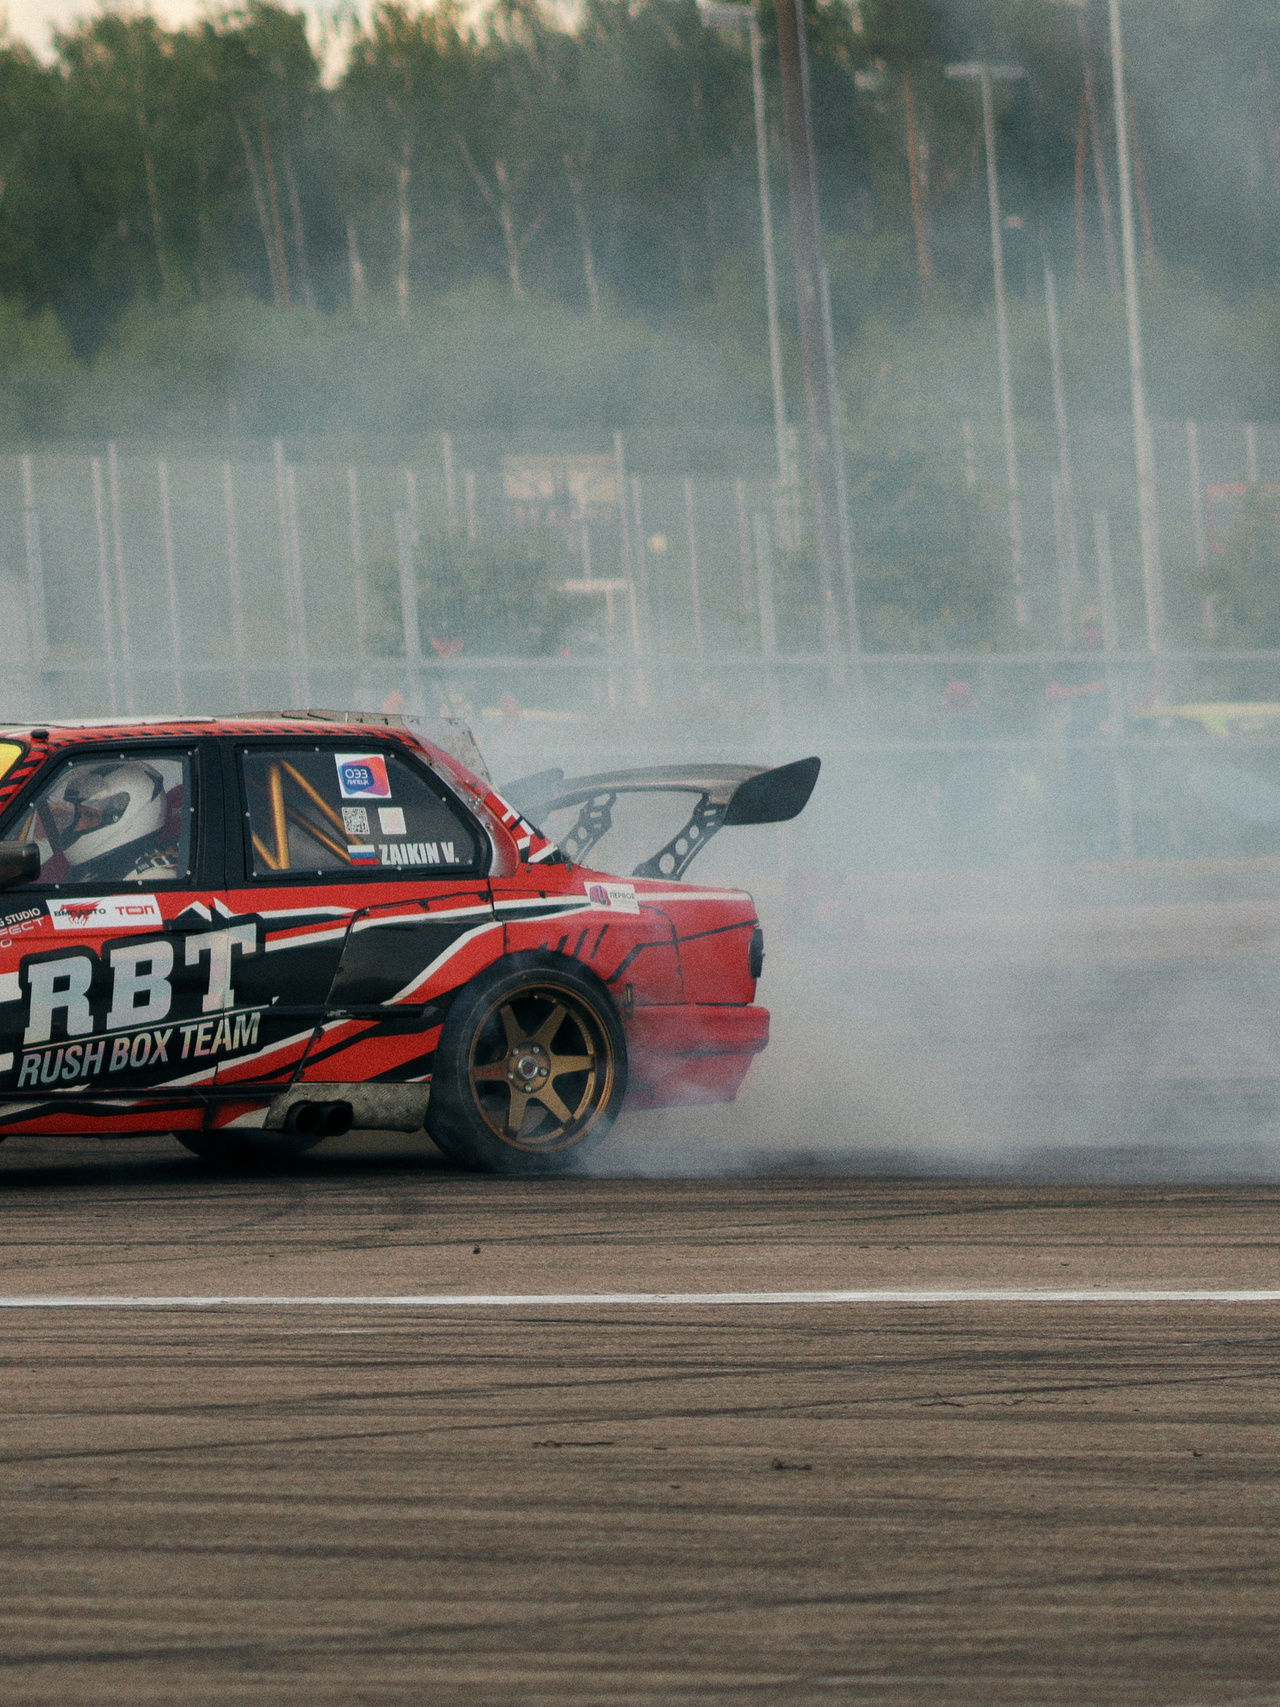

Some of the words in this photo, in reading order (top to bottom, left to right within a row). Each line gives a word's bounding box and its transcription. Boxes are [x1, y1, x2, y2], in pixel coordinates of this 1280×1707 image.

[345, 768, 369, 779] ОЭЗ
[378, 842, 441, 866] ZAIKIN
[441, 841, 460, 864] V.
[4, 907, 41, 925] STUDIO
[23, 923, 257, 1045] RBT
[17, 1041, 106, 1088] RUSH
[109, 1028, 174, 1072] BOX
[179, 1011, 261, 1060] TEAM
